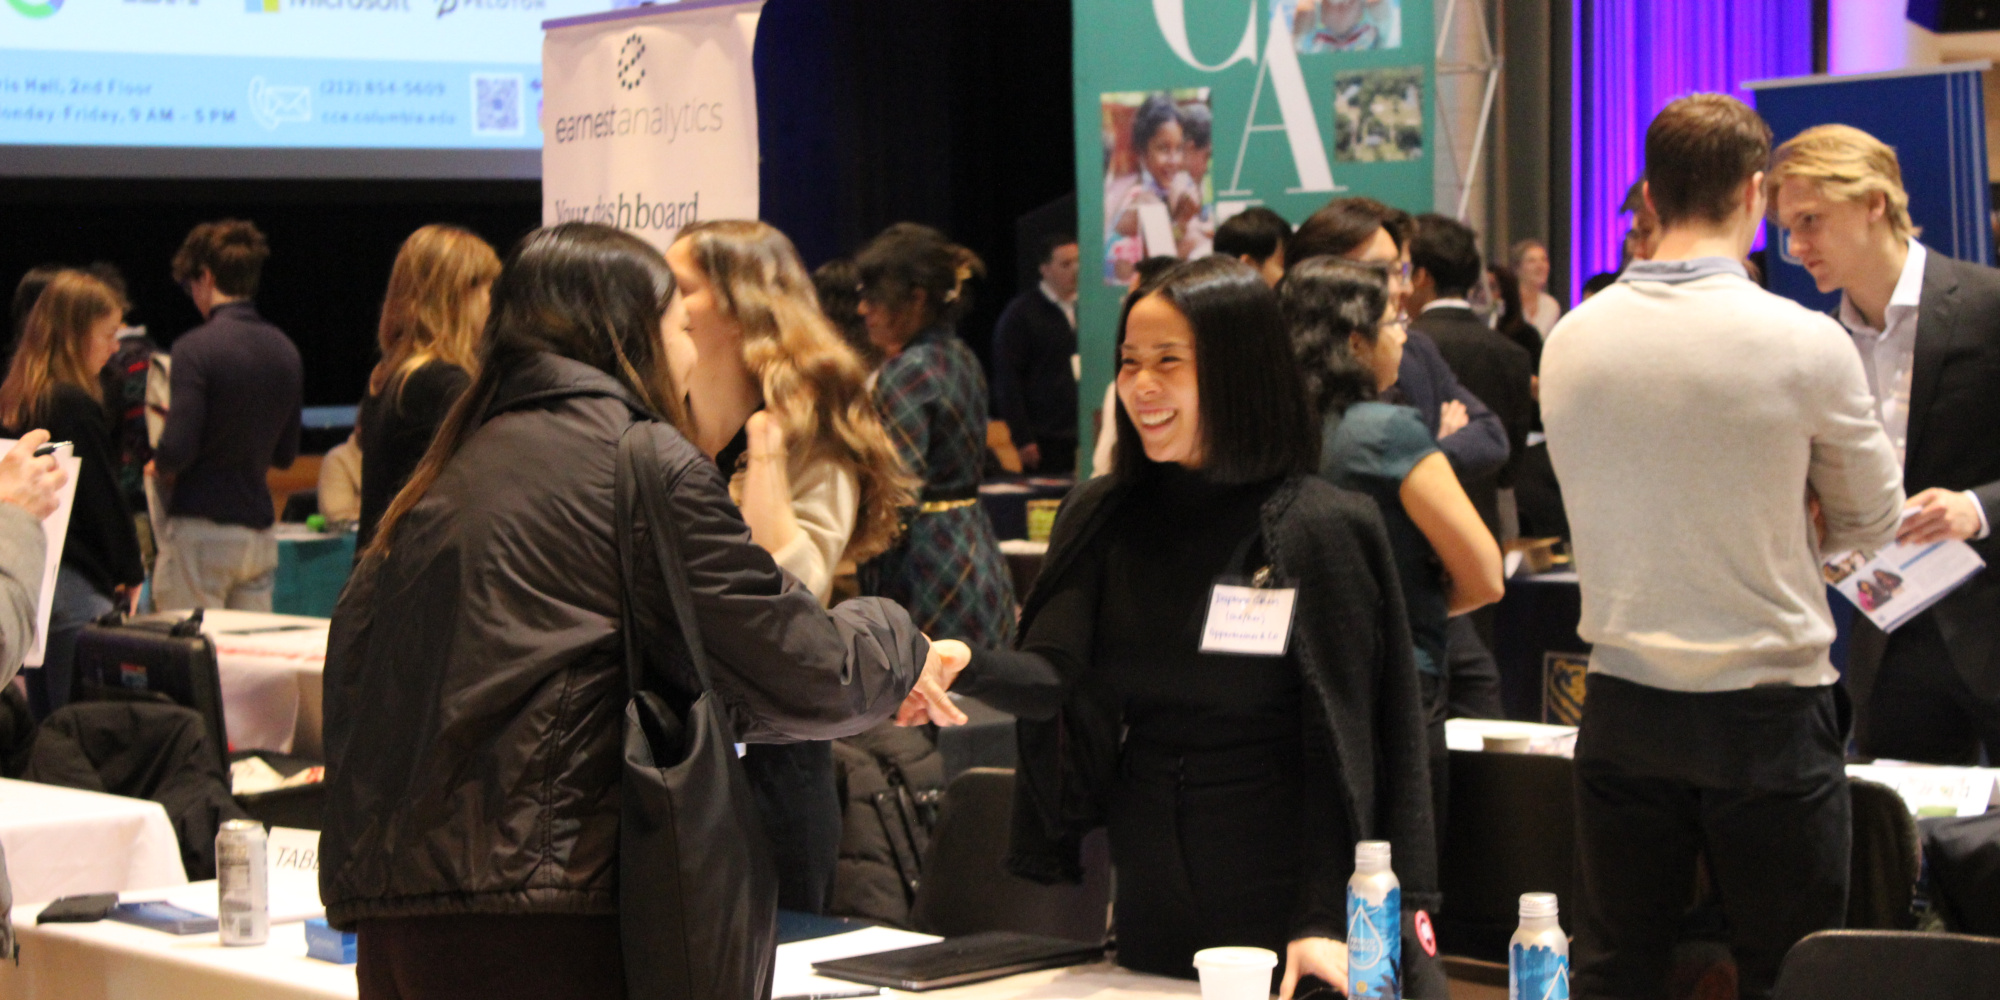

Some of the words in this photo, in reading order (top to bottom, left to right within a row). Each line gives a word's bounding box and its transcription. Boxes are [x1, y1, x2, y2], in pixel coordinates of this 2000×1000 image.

[0, 78, 19, 94] is
[69, 78, 102, 95] 2nd
[107, 79, 152, 97] Floor
[128, 106, 140, 123] 9
[147, 107, 174, 123] AM
[193, 107, 205, 123] 5
[208, 107, 238, 123] PM
[593, 191, 699, 230] dashboard
